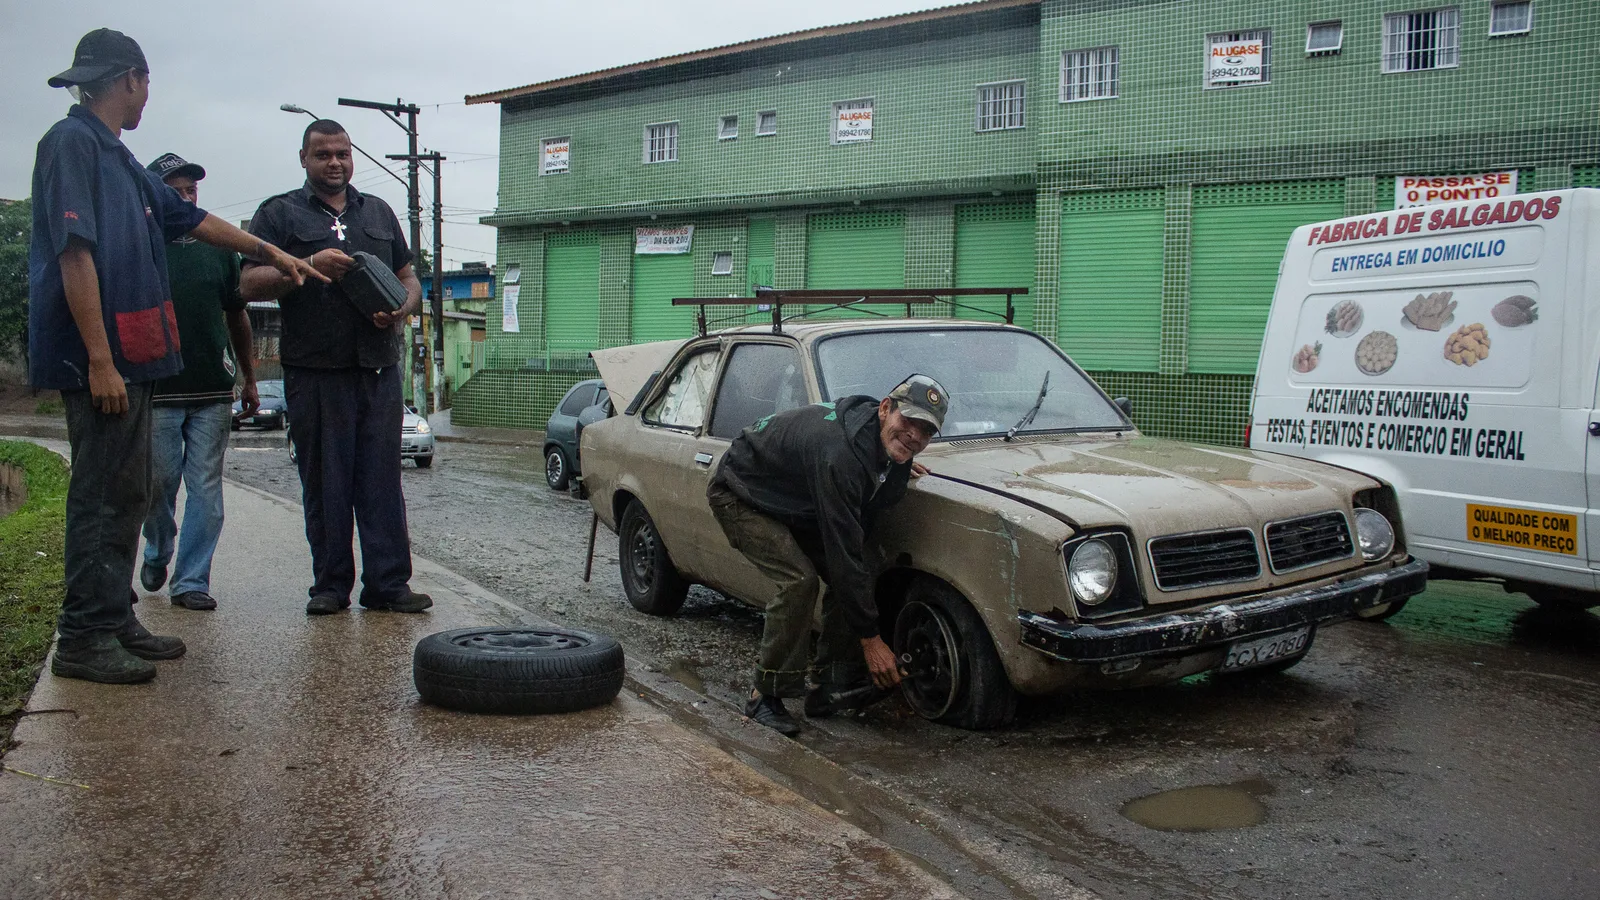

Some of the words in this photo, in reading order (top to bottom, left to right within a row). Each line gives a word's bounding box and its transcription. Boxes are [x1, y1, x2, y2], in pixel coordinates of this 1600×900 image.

[1403, 174, 1510, 188] PASSA-SE
[1407, 190, 1419, 203] O
[1426, 186, 1499, 202] PONTO
[1307, 216, 1389, 247] FABRICA
[1394, 211, 1426, 236] DE
[1428, 196, 1561, 230] SALGADOS
[1331, 251, 1392, 273] ENTREGA
[1396, 248, 1419, 267] EM
[1421, 239, 1506, 264] DOMICILIO
[1306, 389, 1374, 416] ACEITAMOS
[1376, 391, 1469, 421] ENCOMENDAS
[1266, 418, 1306, 449] FESTAS,
[1309, 420, 1363, 448] EVENTOS
[1366, 423, 1375, 448] E
[1378, 423, 1447, 454] COMERCIO
[1450, 428, 1472, 456] EM
[1476, 429, 1525, 461] GERAL
[1473, 508, 1539, 529] QUALIDADE
[1542, 516, 1570, 533] COM
[1472, 525, 1481, 539] O
[1483, 526, 1531, 546] MELHOR
[1533, 533, 1575, 554] PREÇO
